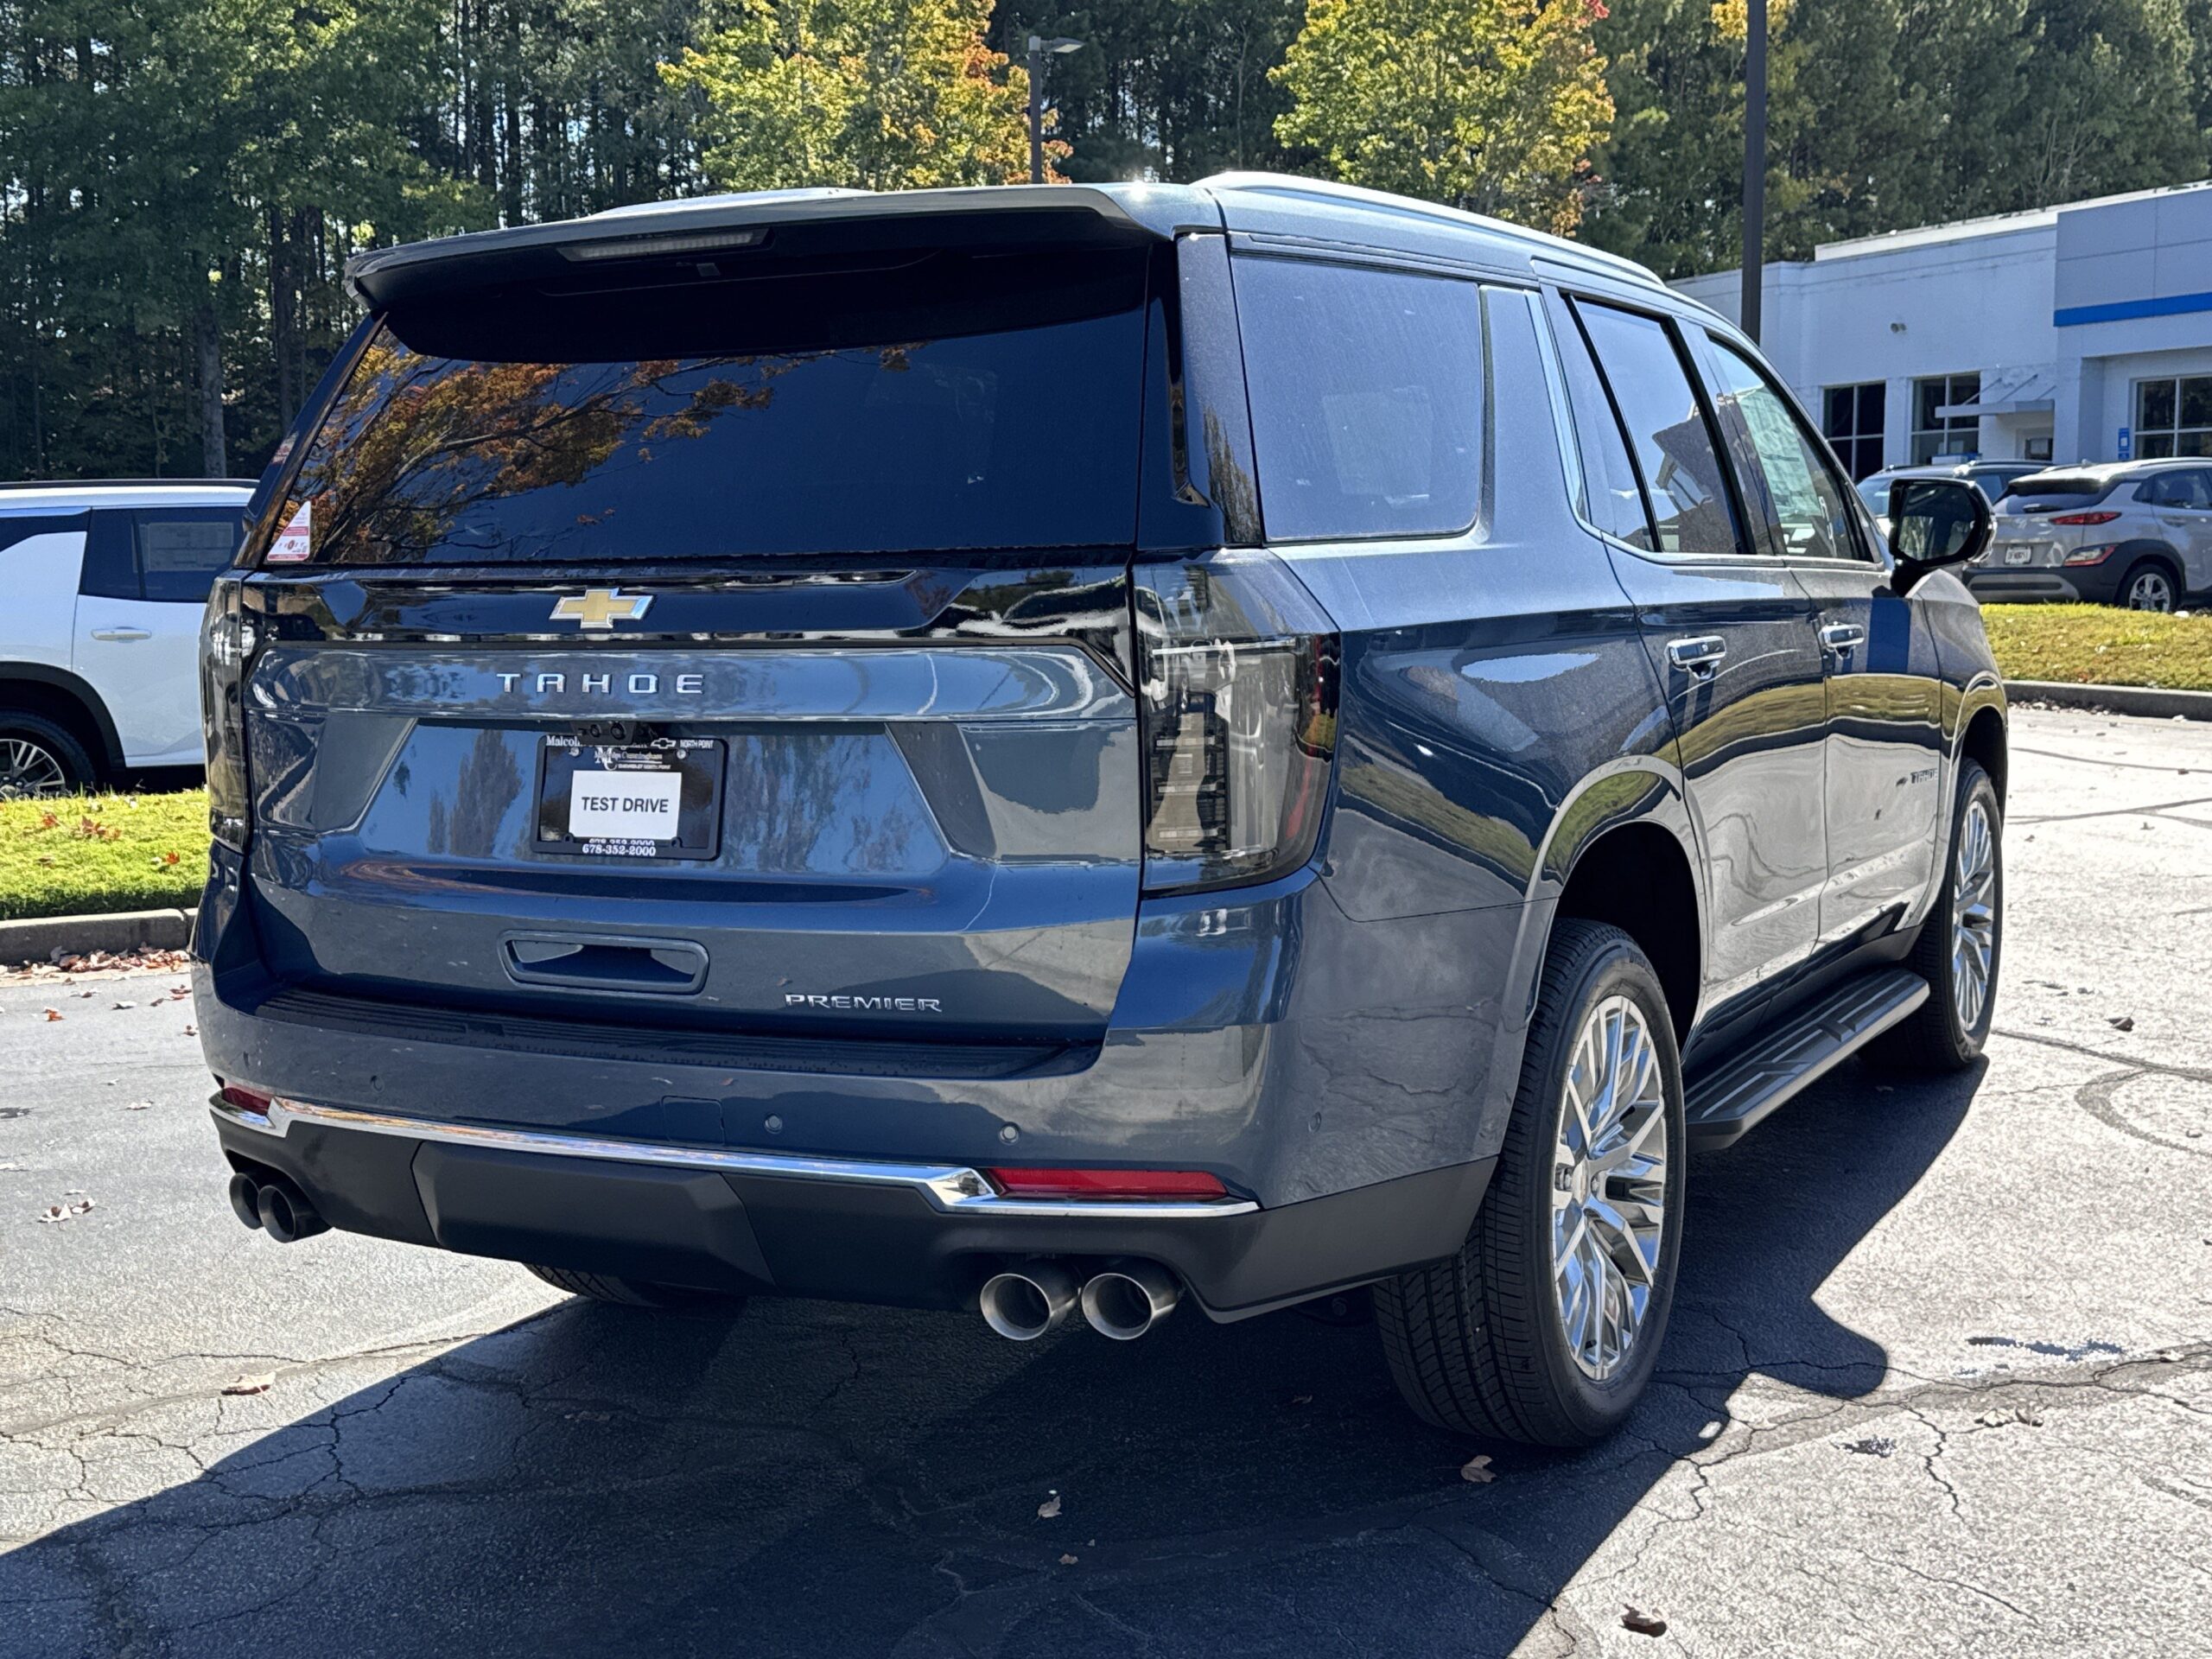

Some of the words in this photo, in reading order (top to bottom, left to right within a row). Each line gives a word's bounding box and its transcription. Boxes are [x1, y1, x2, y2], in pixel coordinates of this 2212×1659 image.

[496, 673, 705, 694] TAHOE
[546, 735, 582, 747] Malcol
[582, 797, 620, 811] TEST
[622, 798, 670, 813] DRIVE
[582, 843, 657, 856] 678-352-2000
[785, 994, 943, 1013] PREMIER
